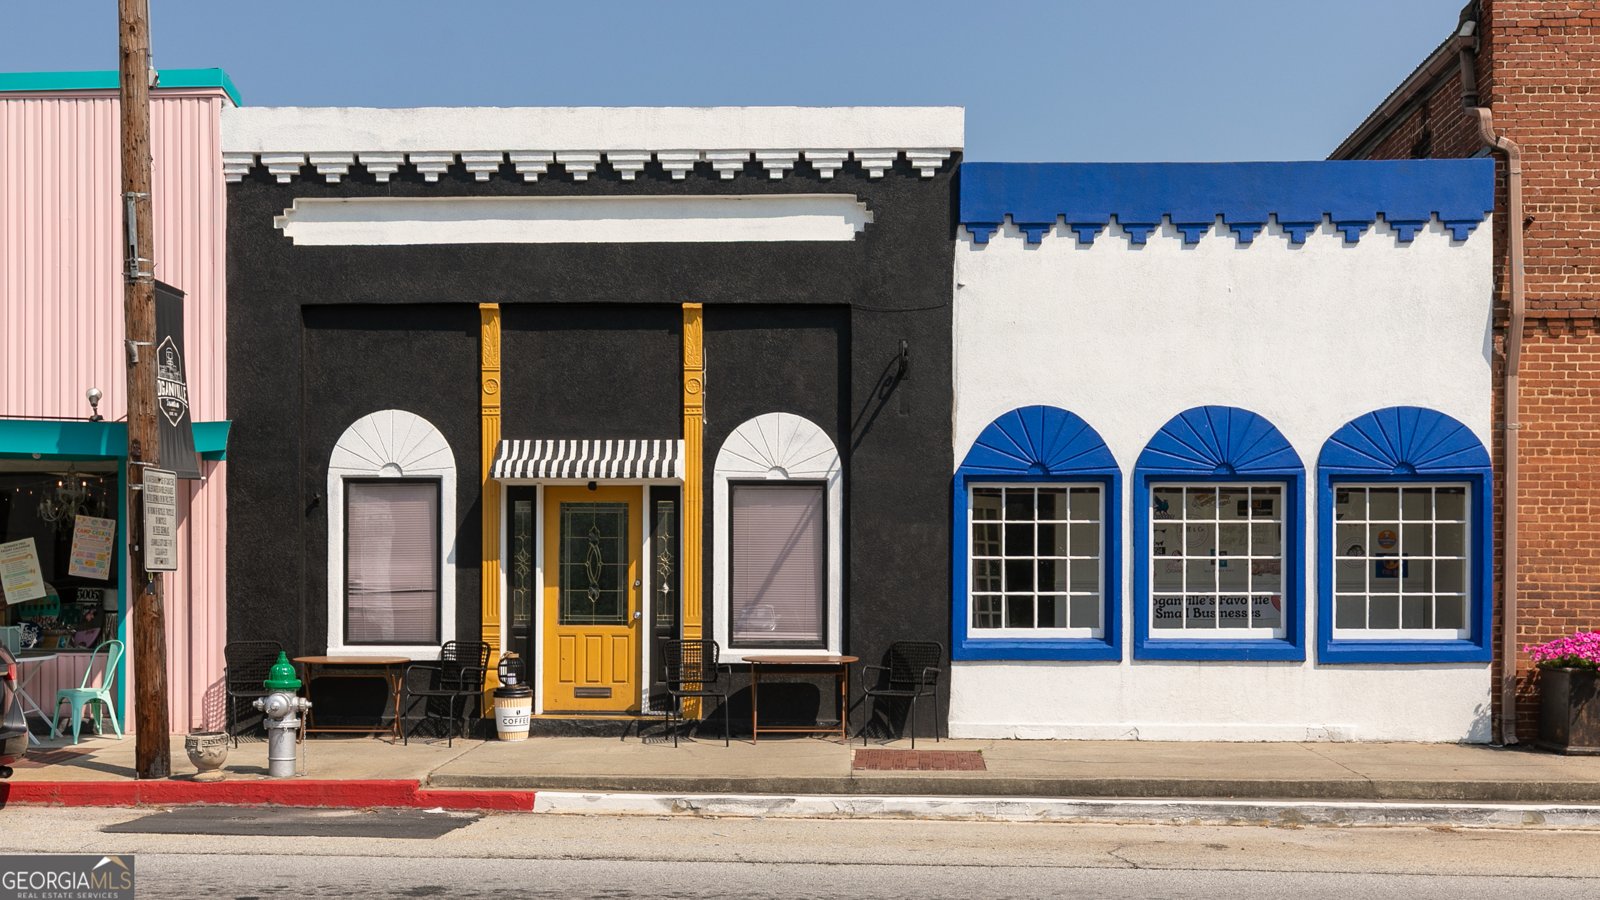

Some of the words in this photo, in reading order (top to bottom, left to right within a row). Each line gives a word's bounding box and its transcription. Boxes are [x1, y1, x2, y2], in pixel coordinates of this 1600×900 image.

[157, 380, 187, 404] OGANVILLE
[1153, 595, 1215, 608] oganille's
[1155, 607, 1190, 618] Smal
[1193, 607, 1261, 618] Busnesss
